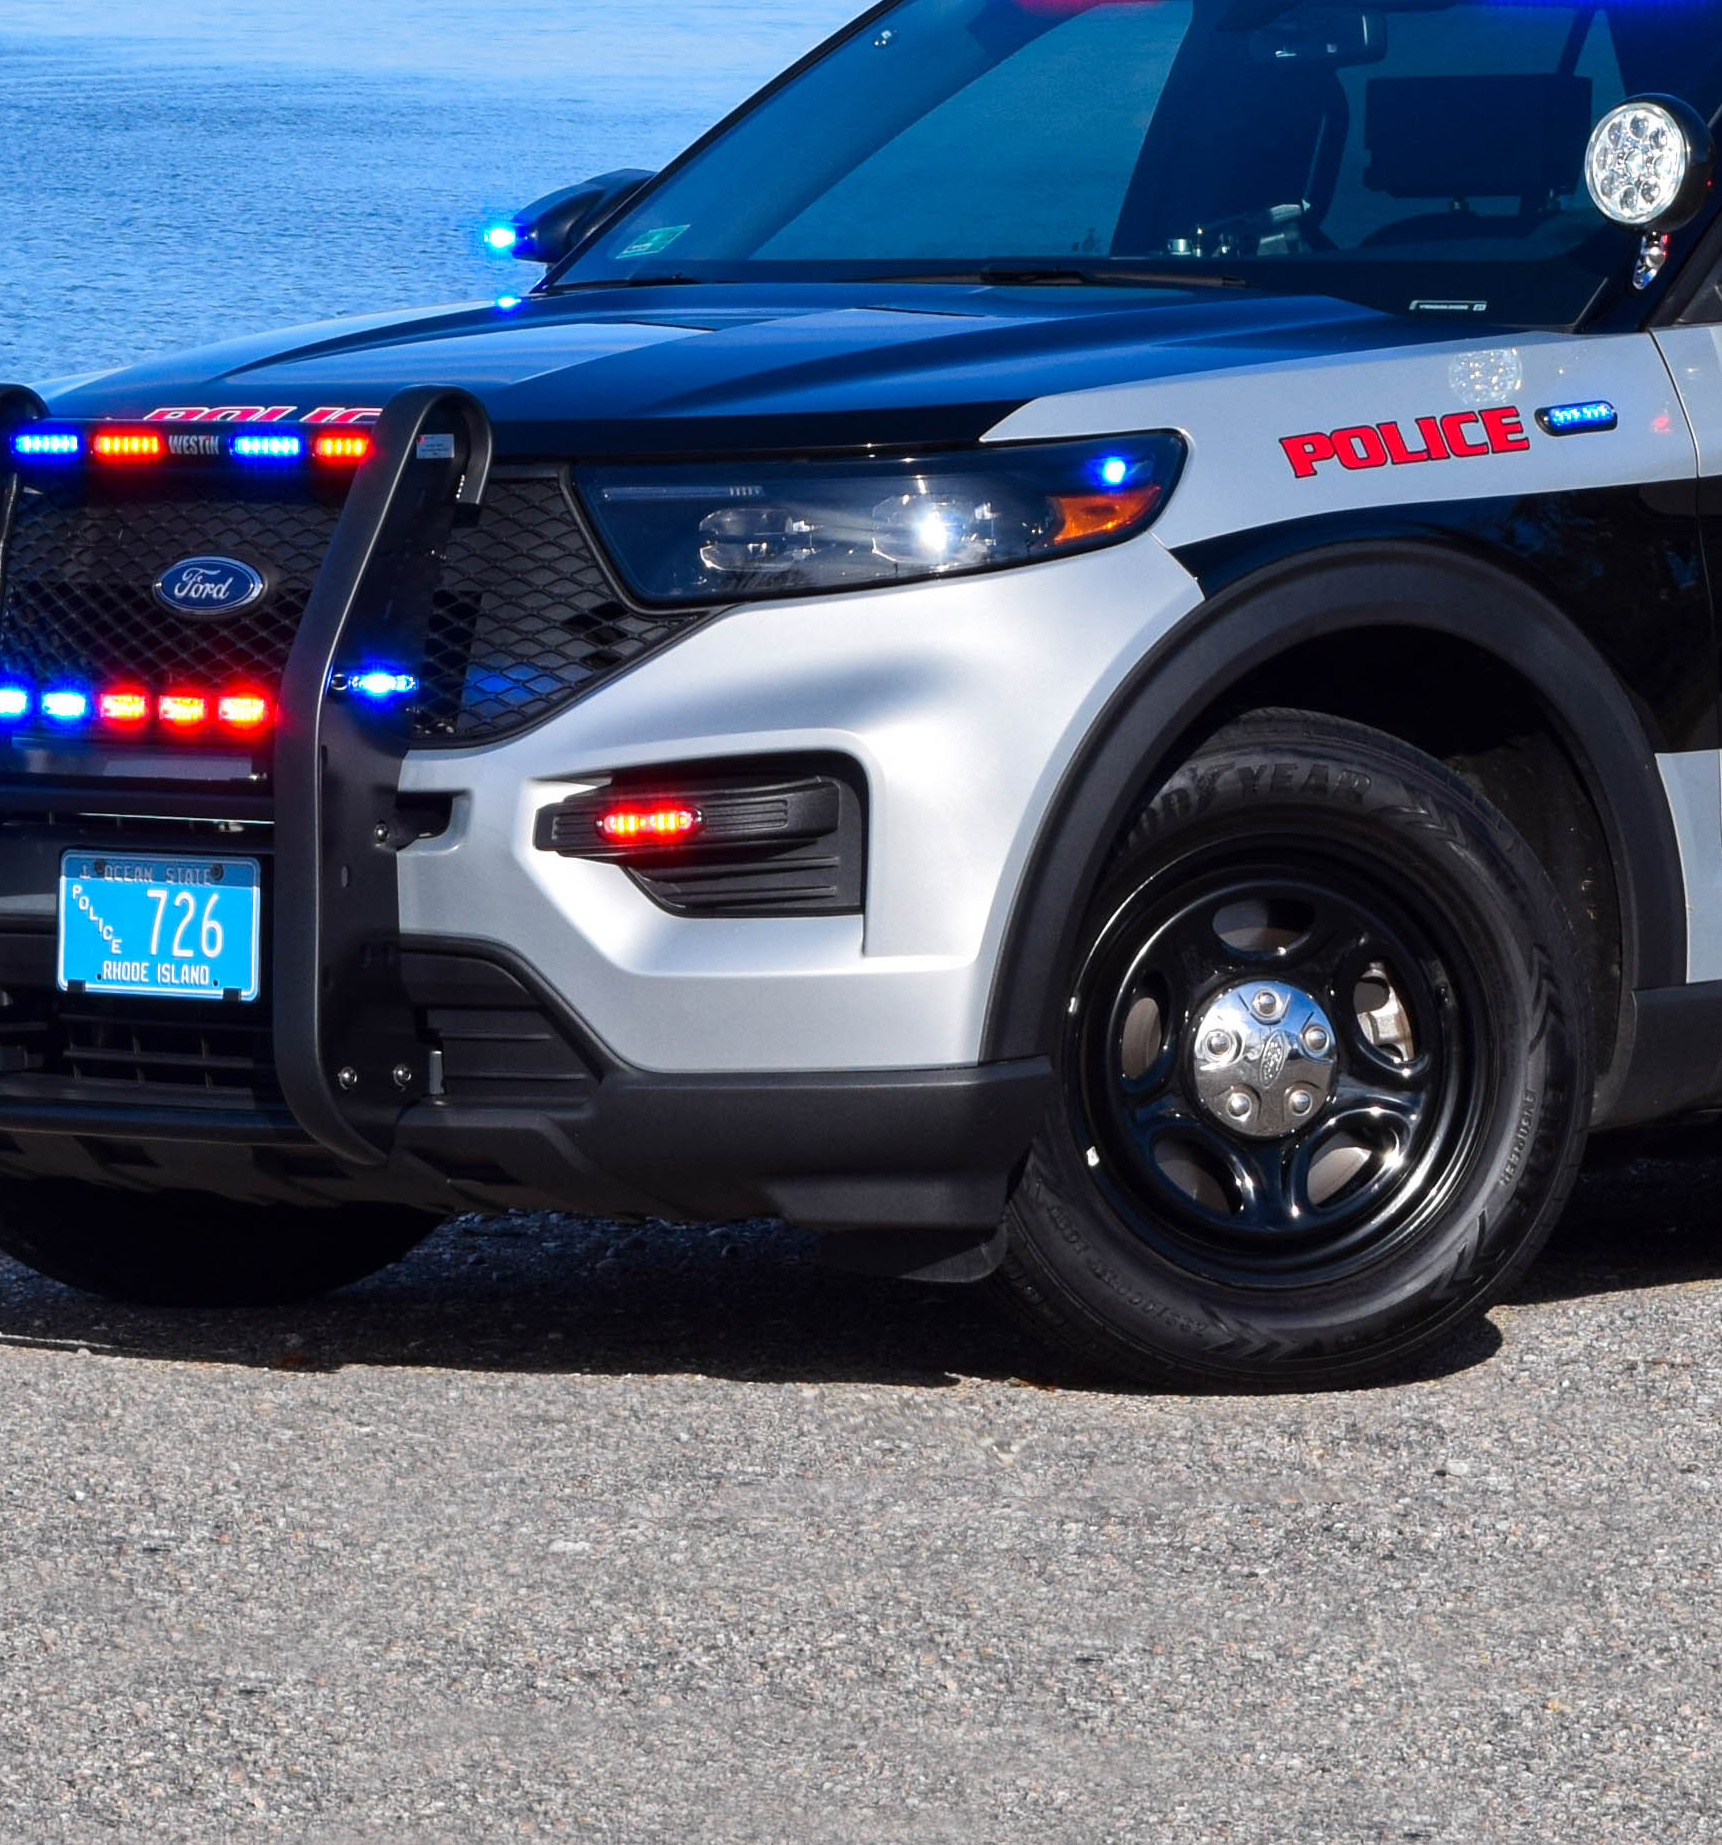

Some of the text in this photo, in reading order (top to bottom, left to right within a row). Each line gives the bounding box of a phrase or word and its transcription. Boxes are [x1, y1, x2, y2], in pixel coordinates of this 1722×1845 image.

[1280, 405, 1531, 479] POLICE
[174, 567, 231, 600] Ford
[104, 864, 212, 885] OCEAN STATE
[72, 884, 122, 954] POLICE
[147, 889, 223, 958] 726
[103, 960, 209, 986] RHODE ISLAND
